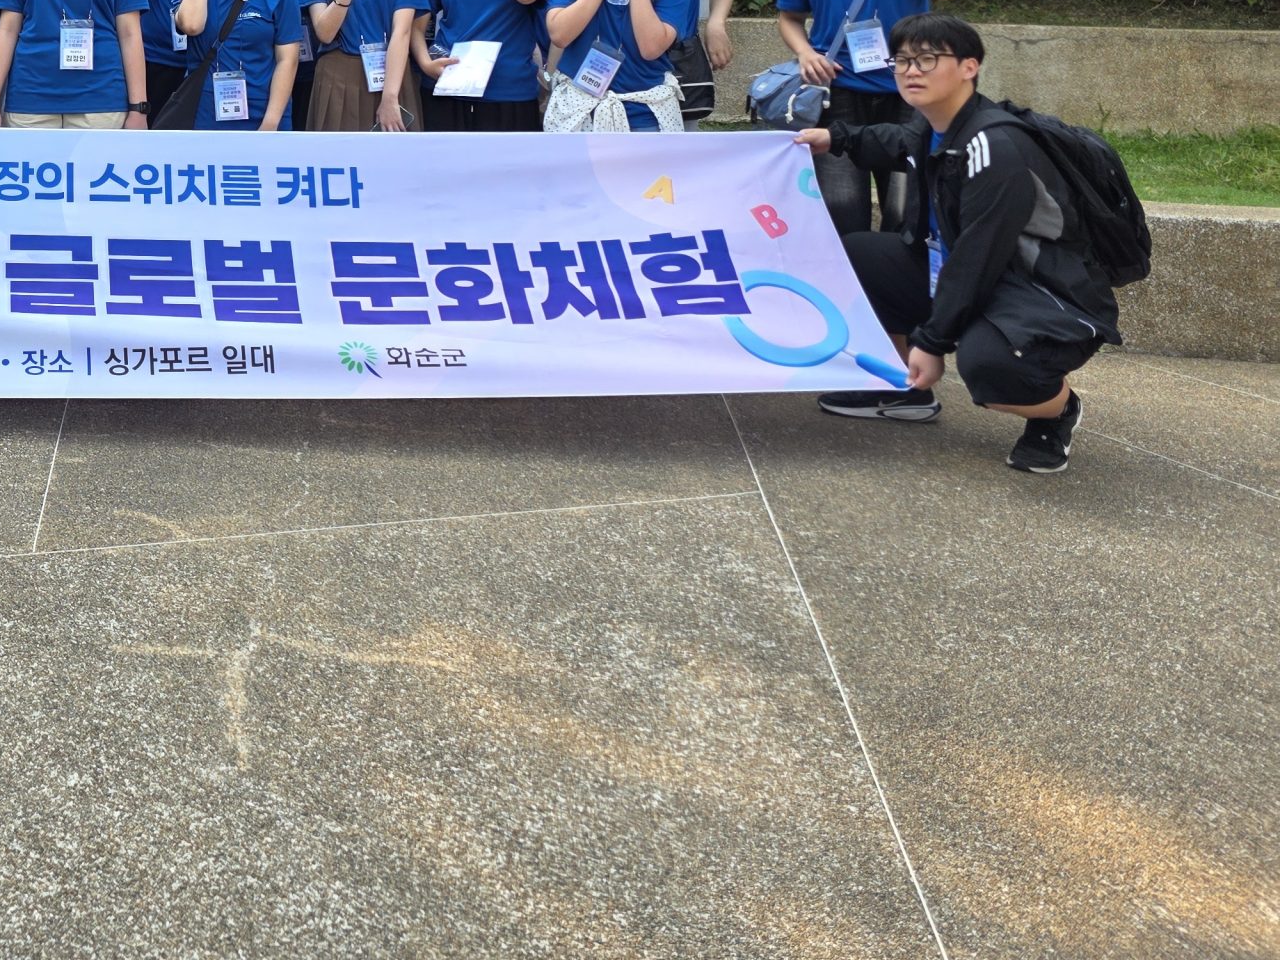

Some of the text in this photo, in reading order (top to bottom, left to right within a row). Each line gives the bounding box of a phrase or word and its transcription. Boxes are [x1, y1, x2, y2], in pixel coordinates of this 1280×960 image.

[89, 162, 263, 207] 스위치를
[276, 166, 364, 209] 켜다
[5, 233, 303, 325] 글로벌
[330, 228, 752, 325] 문화체험
[20, 344, 276, 376] 장소 싱가포르 일대
[386, 346, 469, 369] 화순군
